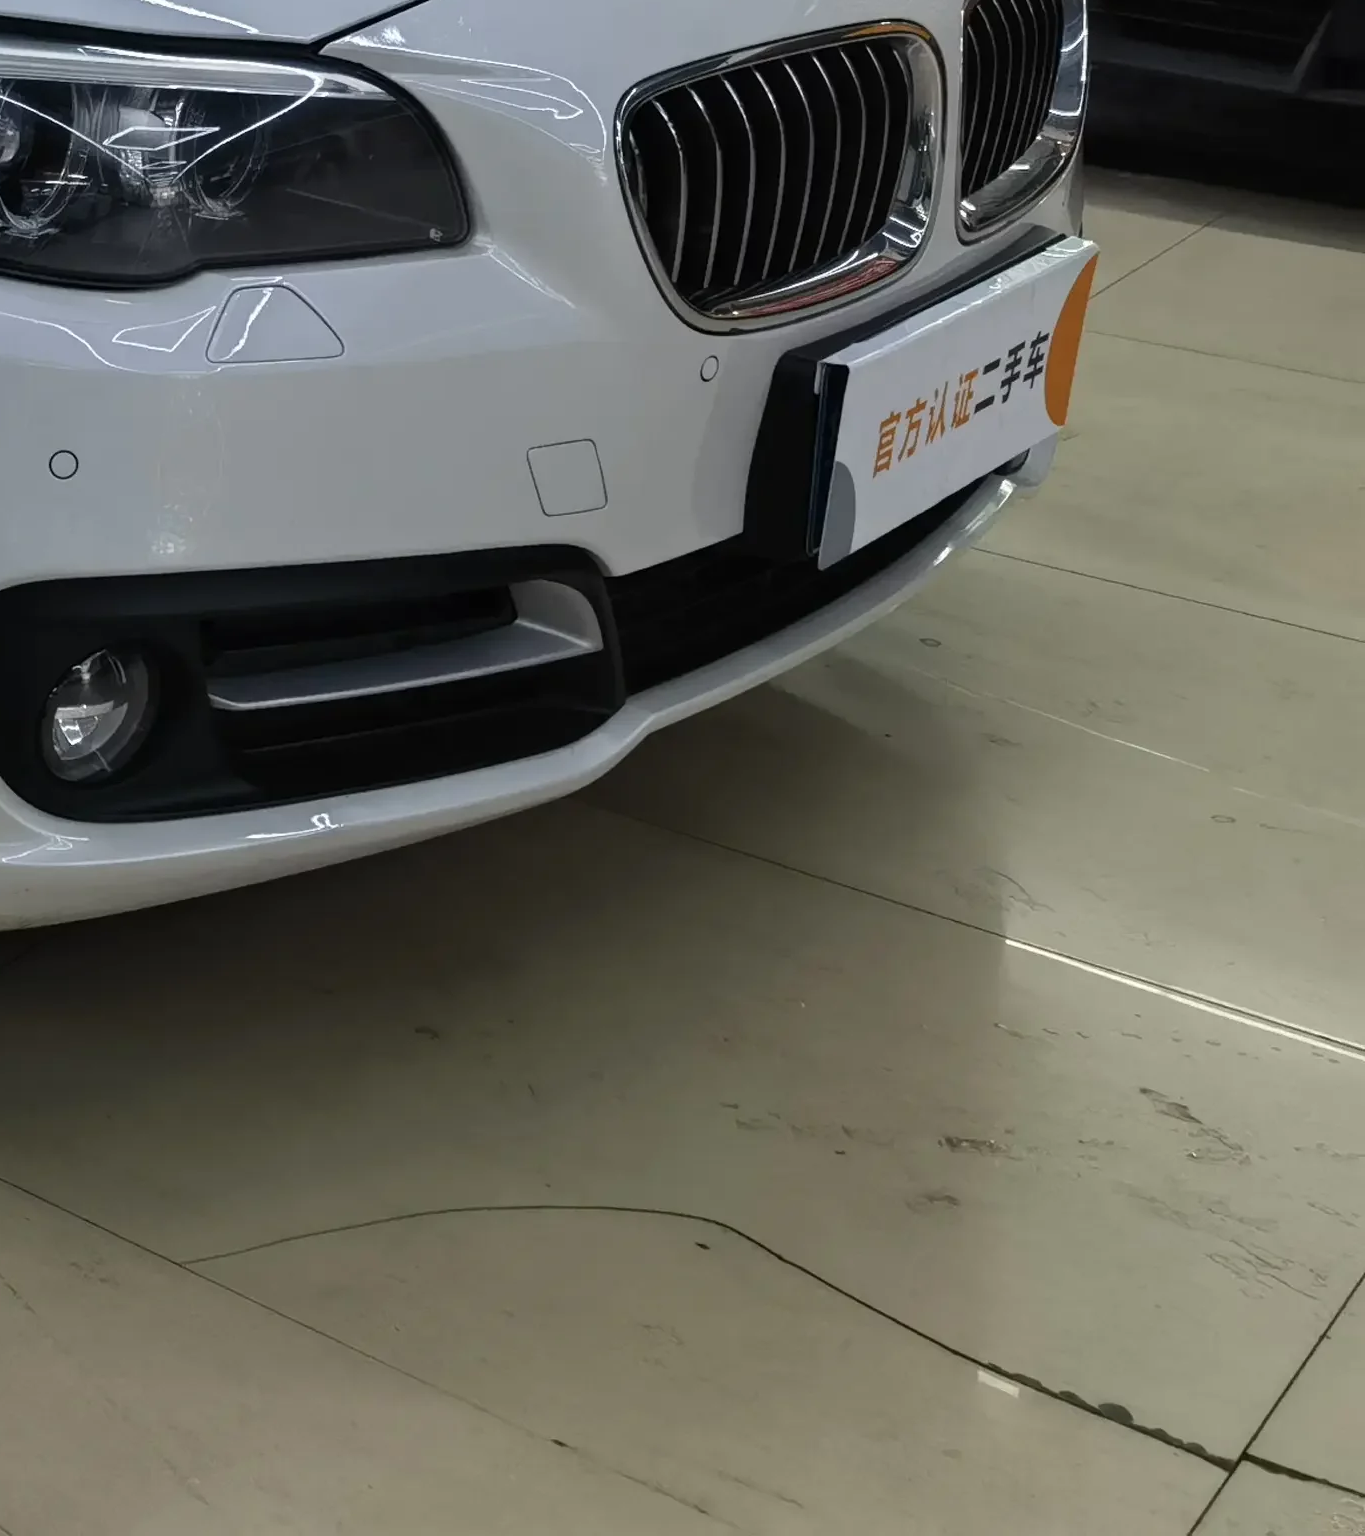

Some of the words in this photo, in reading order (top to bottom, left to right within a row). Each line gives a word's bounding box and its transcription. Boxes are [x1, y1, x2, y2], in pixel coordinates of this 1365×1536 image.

[872, 330, 1051, 479] 官方认证二手车
